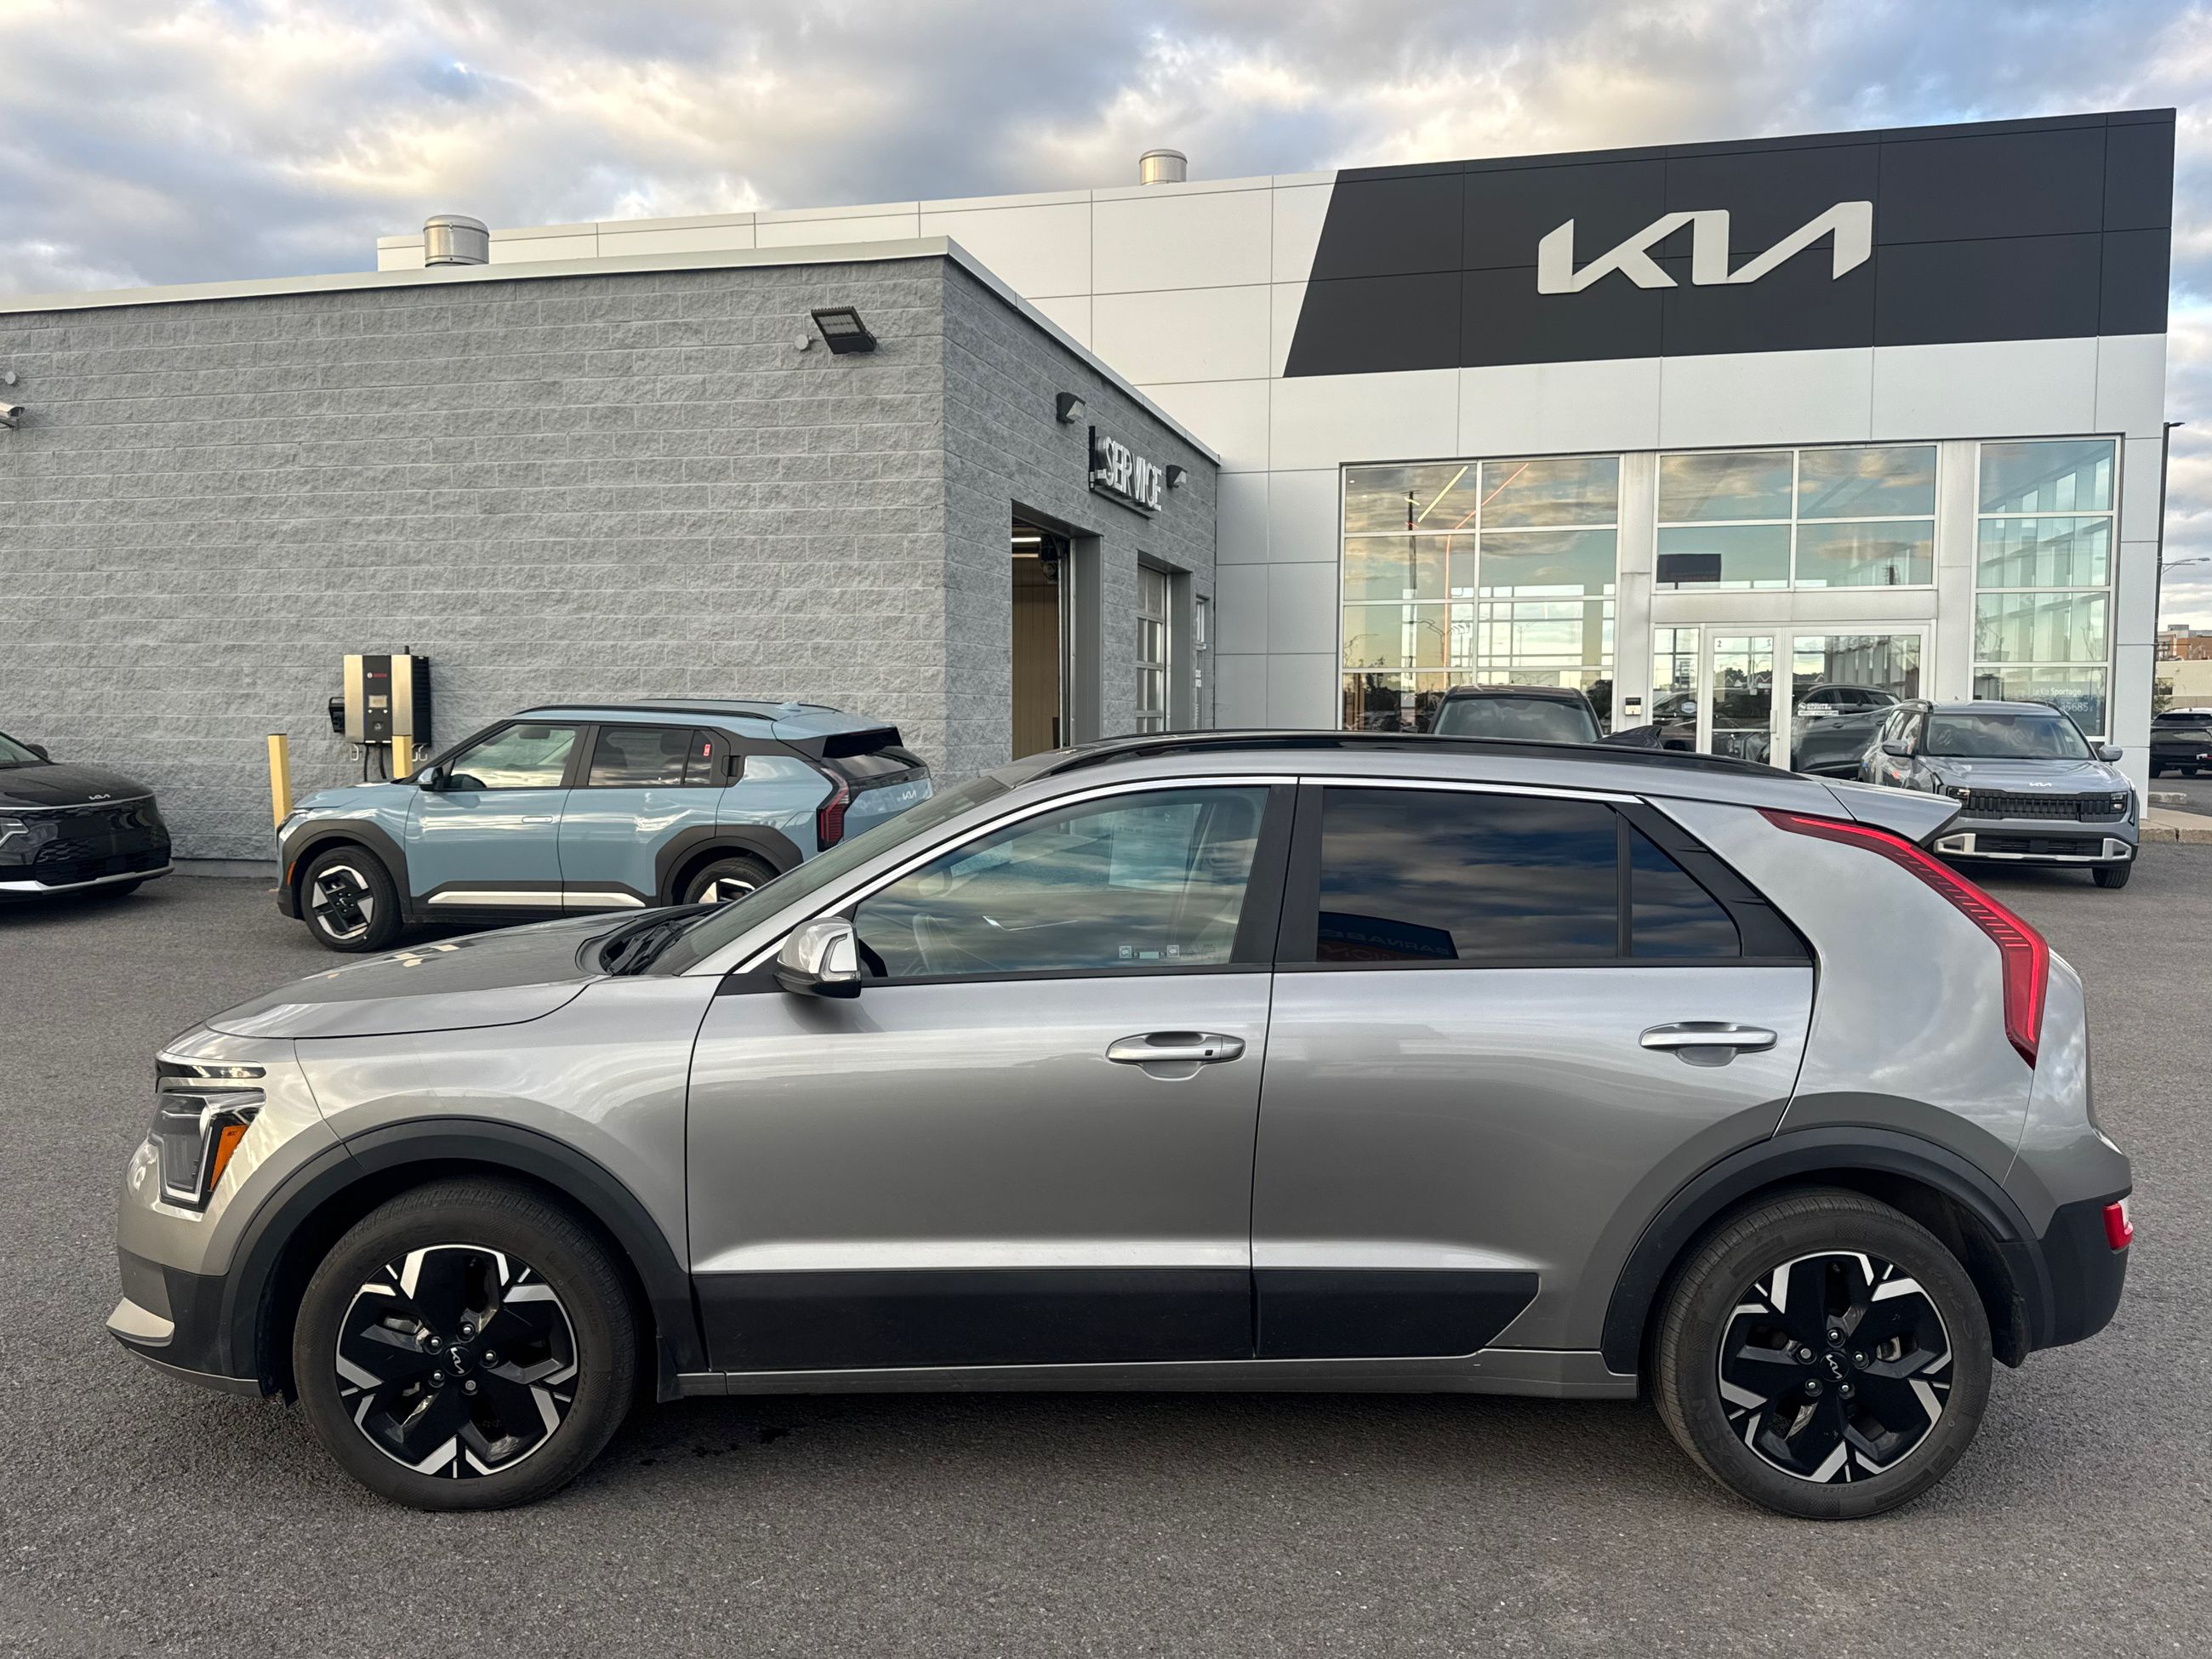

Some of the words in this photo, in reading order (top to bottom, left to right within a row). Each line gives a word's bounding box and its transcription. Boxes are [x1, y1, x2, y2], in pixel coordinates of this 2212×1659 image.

[1537, 201, 1873, 294] KIA
[1103, 436, 1162, 511] SERVICE
[2050, 687, 2082, 698] Sportage
